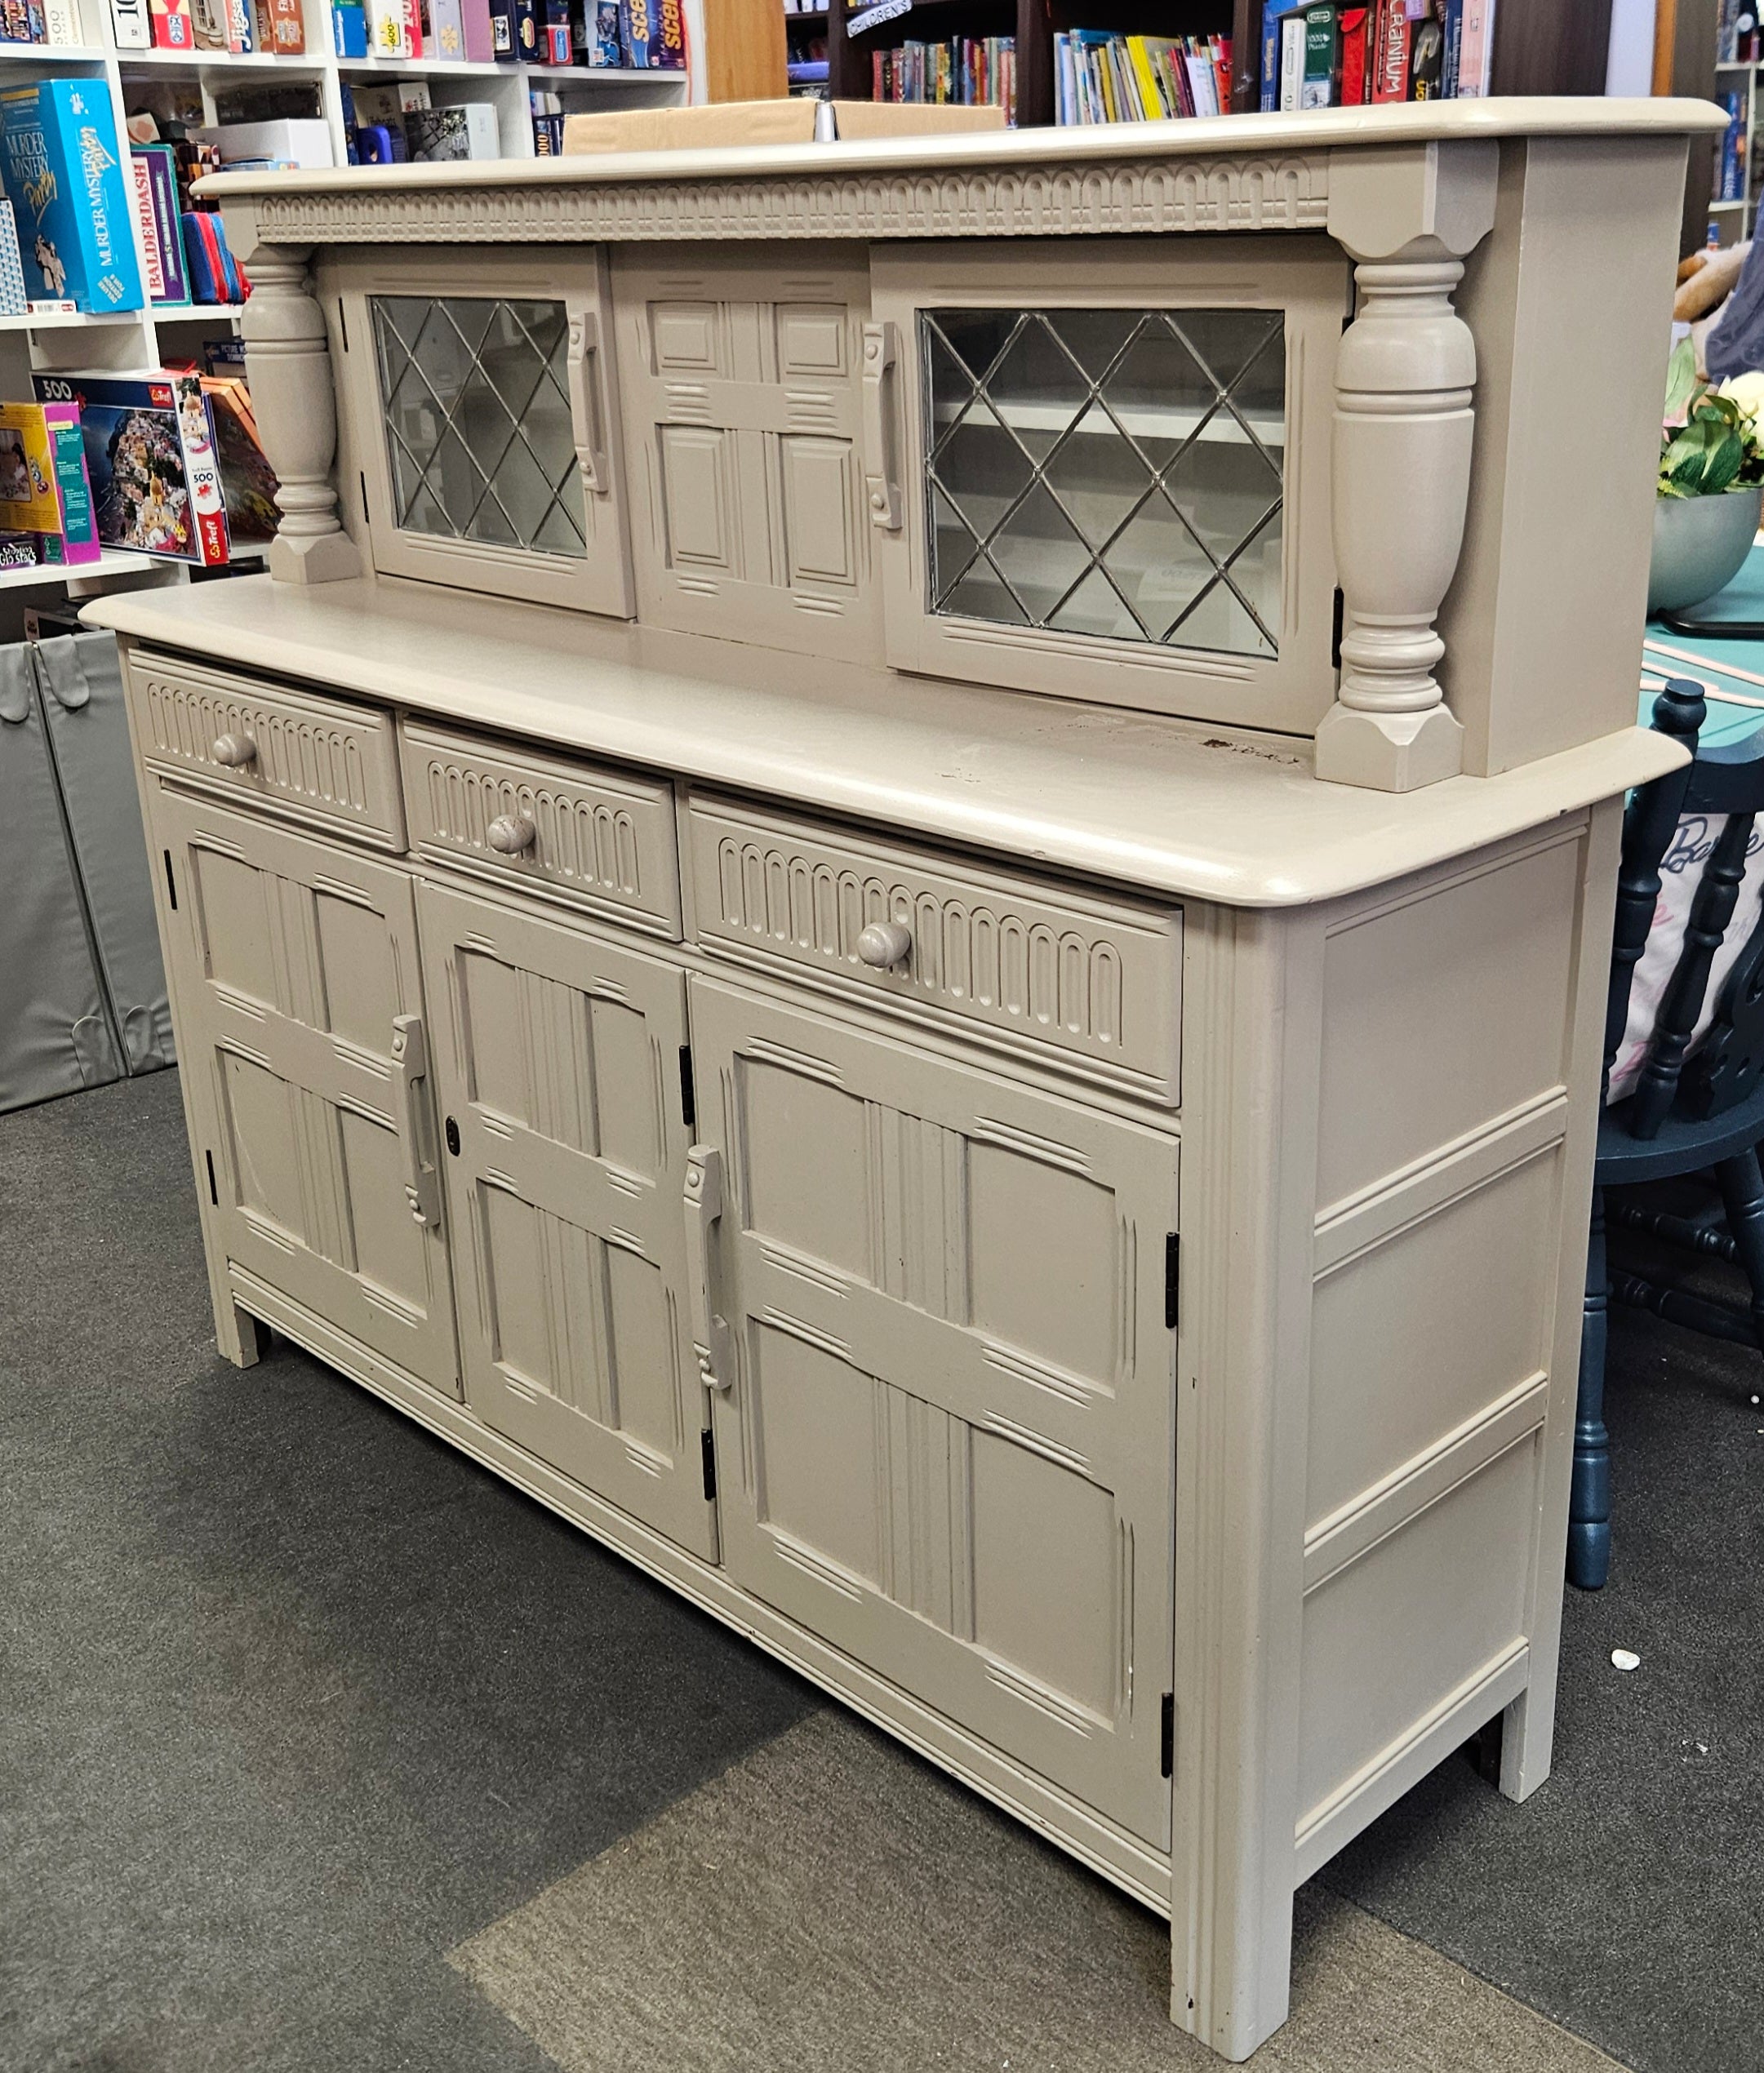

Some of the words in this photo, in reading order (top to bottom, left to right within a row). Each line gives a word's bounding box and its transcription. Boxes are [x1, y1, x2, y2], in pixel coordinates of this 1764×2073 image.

[50, 11, 64, 45] 500
[387, 24, 396, 44] 600
[6, 131, 47, 157] MURDER
[11, 153, 49, 179] MYSTERY
[82, 149, 104, 207] MYSTERY
[92, 208, 113, 267] MURDER
[133, 164, 162, 289] BALDERDASH
[42, 380, 73, 400] 500
[193, 473, 214, 483] 500
[206, 520, 220, 545] Trefl
